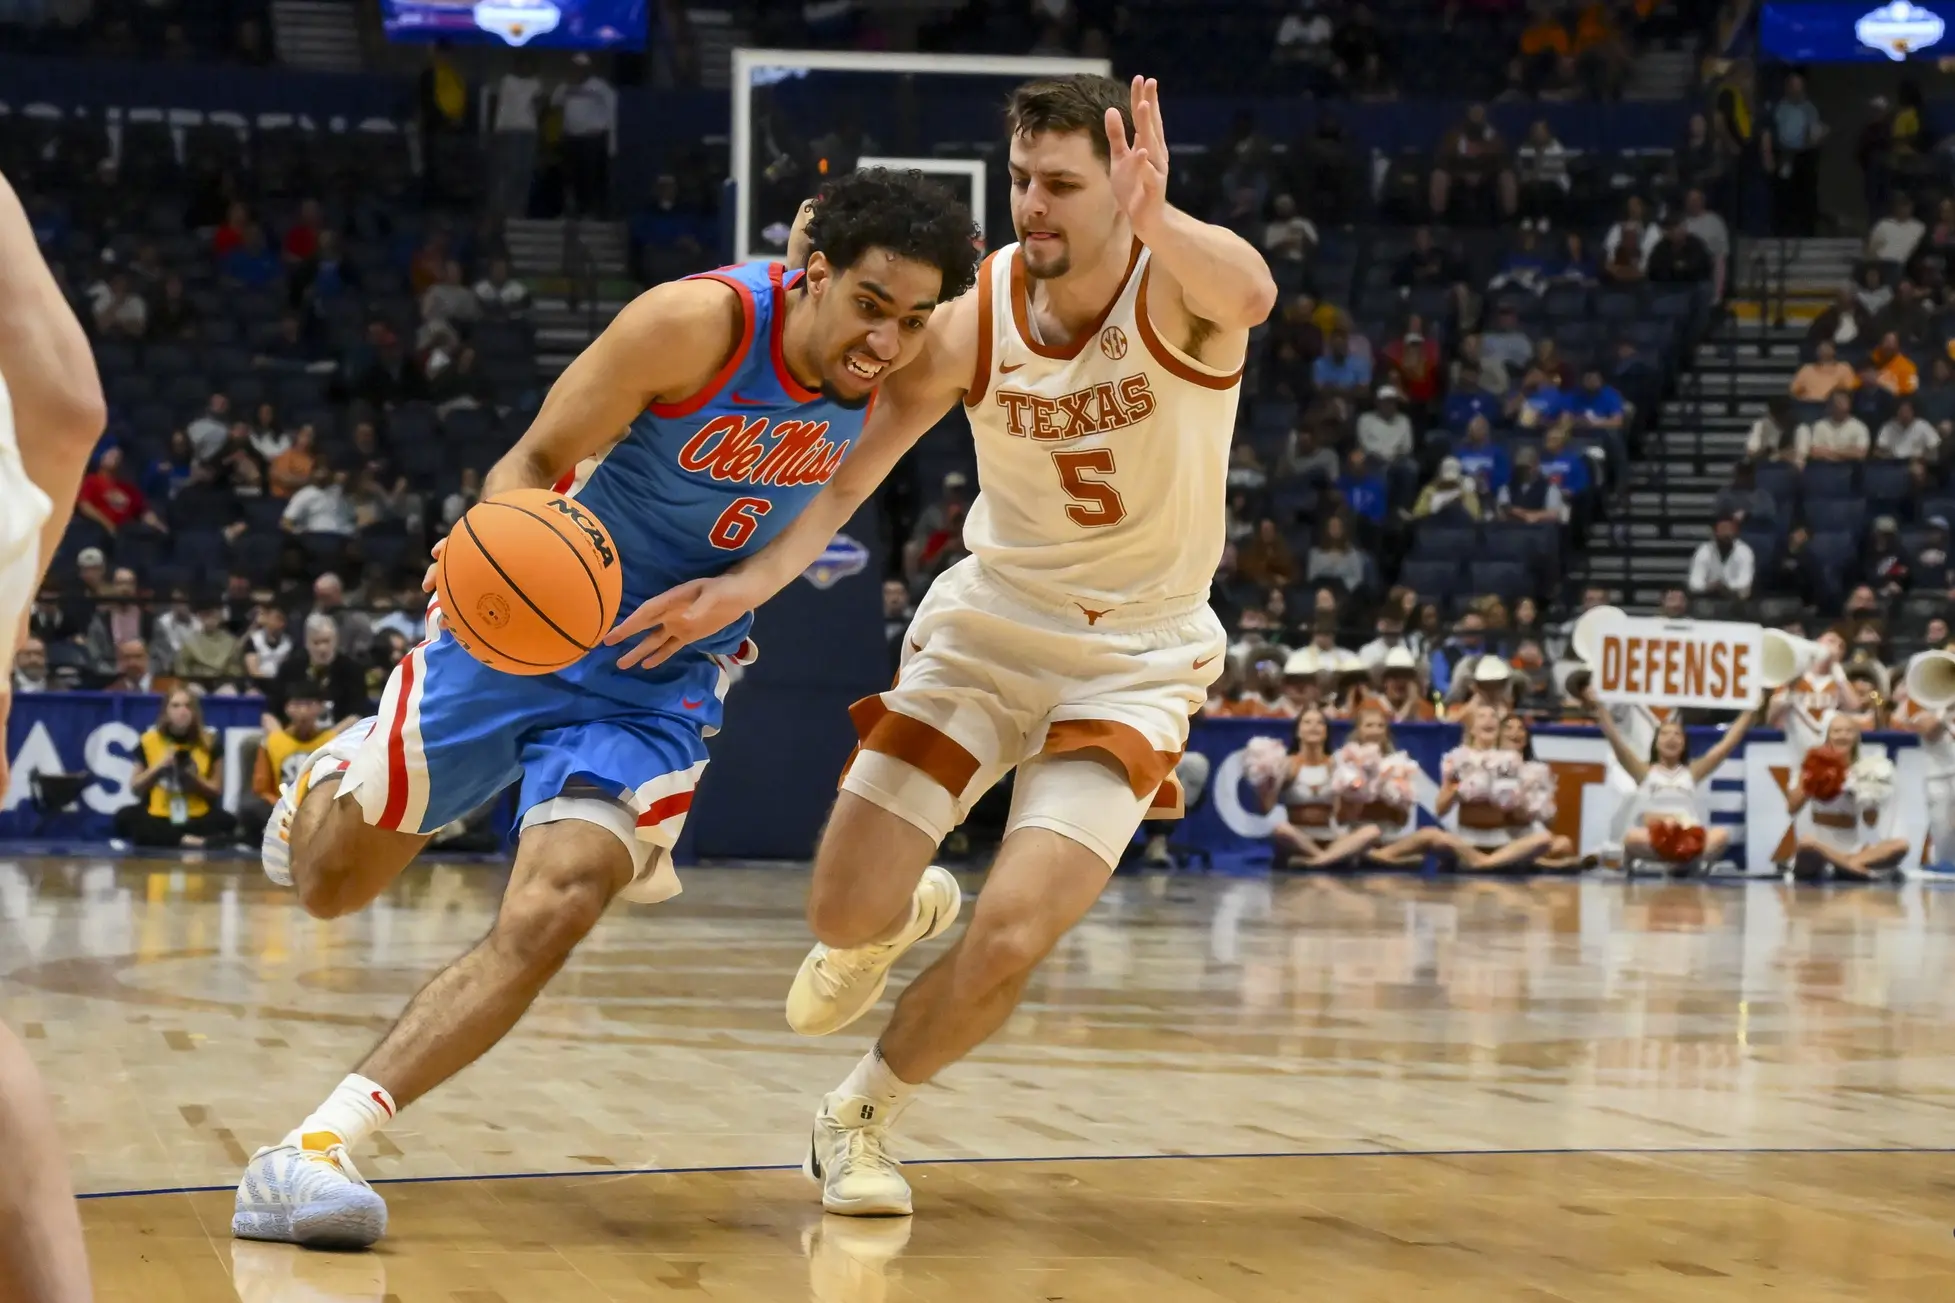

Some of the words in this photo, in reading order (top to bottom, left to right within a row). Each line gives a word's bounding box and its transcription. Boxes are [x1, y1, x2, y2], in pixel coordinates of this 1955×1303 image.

[1101, 326, 1128, 360] SEC
[996, 372, 1157, 442] TEXAS
[678, 415, 770, 483] Ole
[750, 420, 851, 487] Miss
[1051, 448, 1128, 528] 5
[546, 498, 615, 569] NCAA
[708, 496, 773, 551] 6
[1602, 636, 1749, 699] DEFENSE
